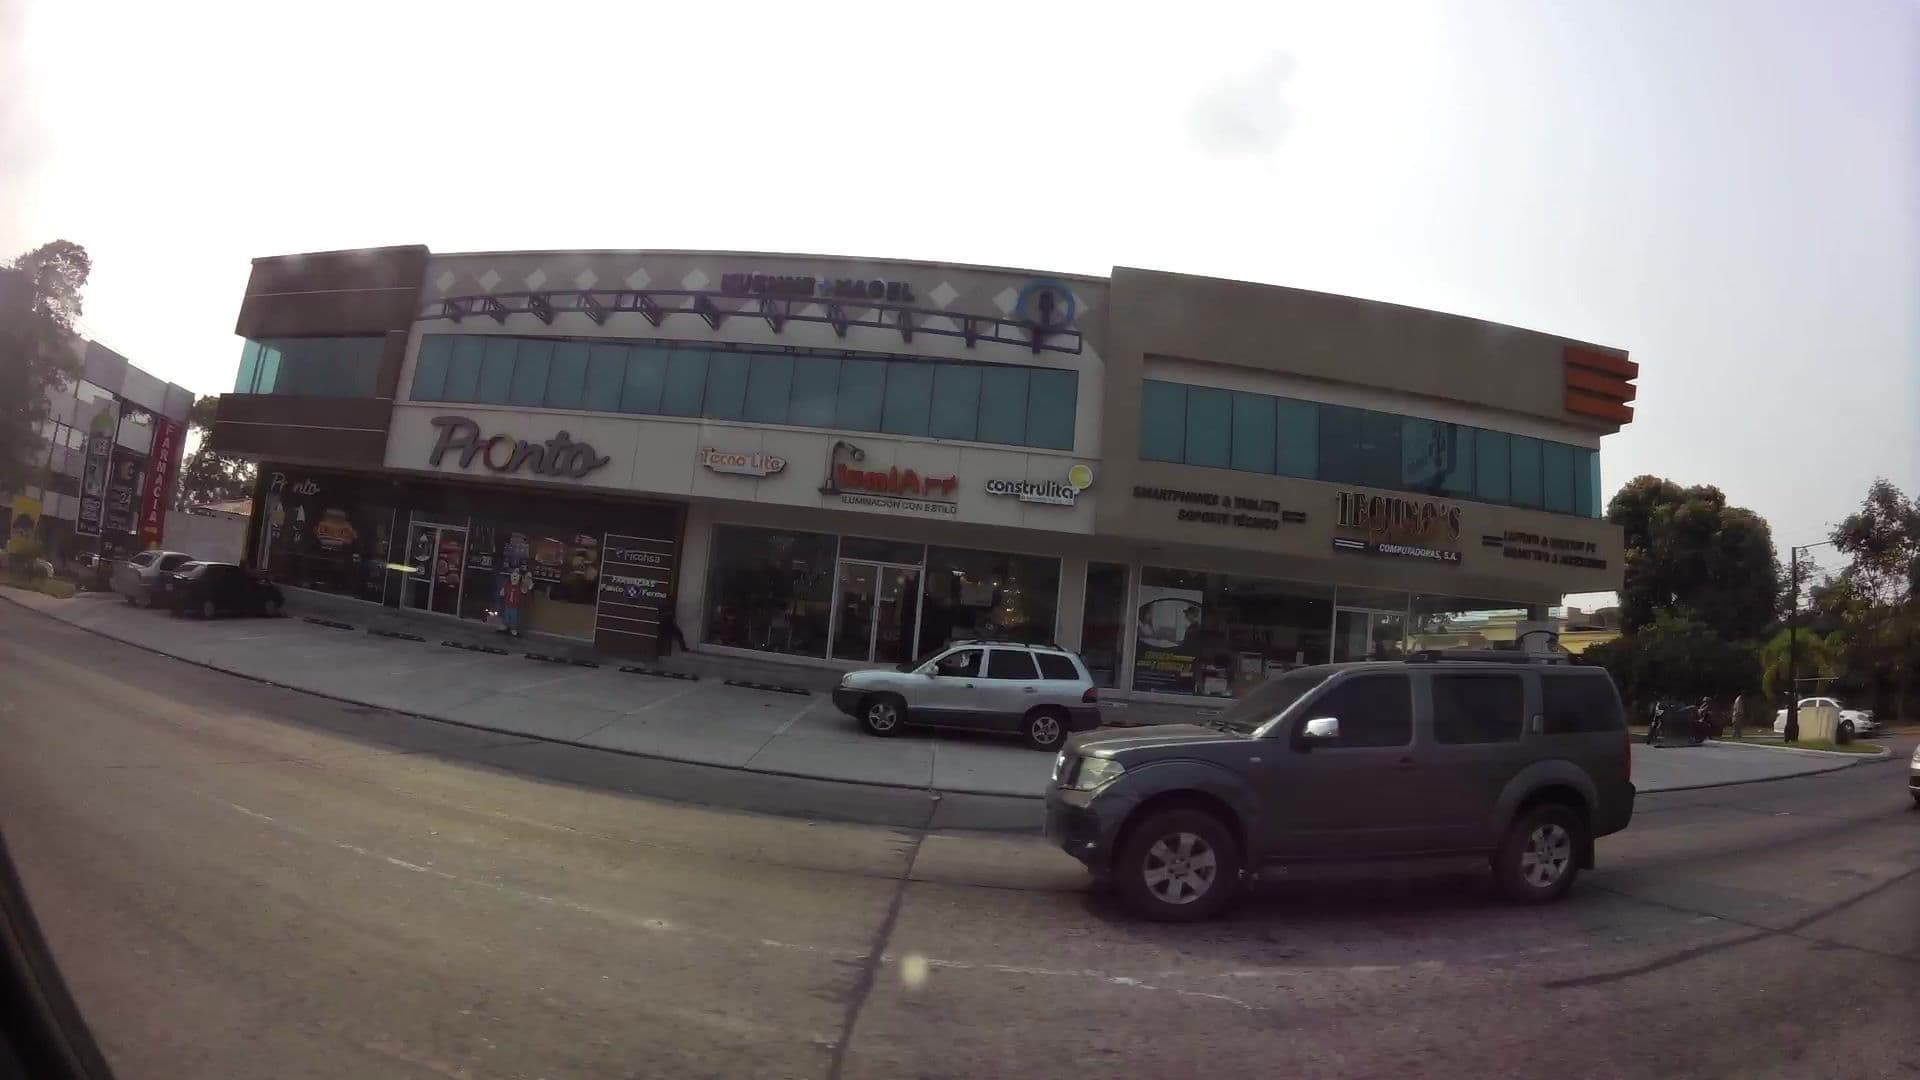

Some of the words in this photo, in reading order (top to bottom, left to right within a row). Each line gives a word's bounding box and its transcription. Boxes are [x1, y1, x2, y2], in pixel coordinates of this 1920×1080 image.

[429, 415, 611, 479] Pronto
[149, 424, 177, 522] FARMACIA
[987, 479, 1074, 499] construlita
[902, 501, 923, 511] CON
[924, 503, 957, 514] ESTILO
